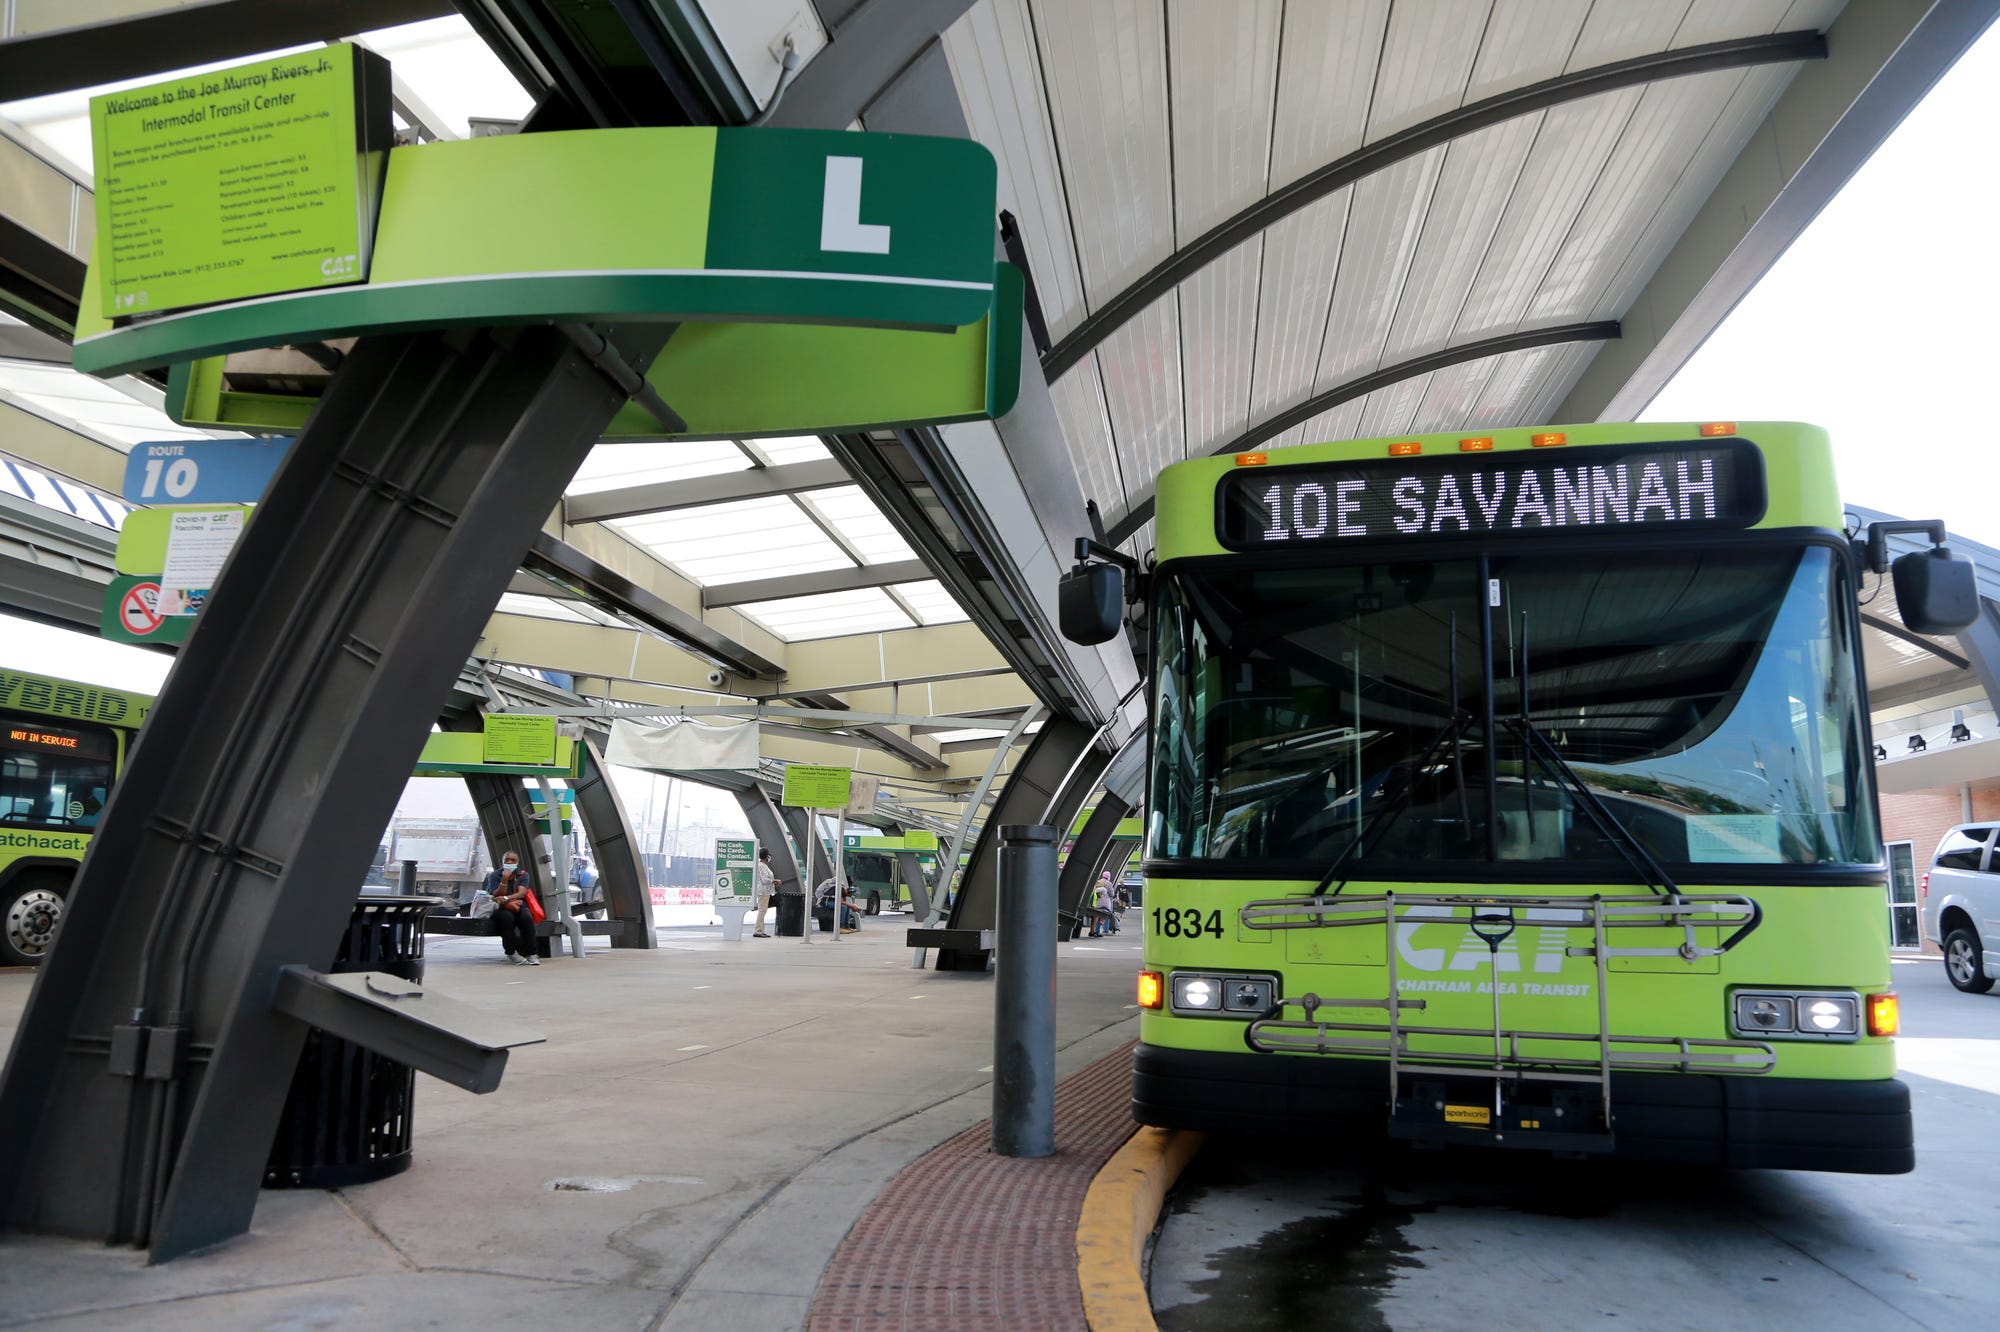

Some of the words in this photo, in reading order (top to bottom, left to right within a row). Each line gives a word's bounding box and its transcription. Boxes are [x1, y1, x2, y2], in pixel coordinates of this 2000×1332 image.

[106, 97, 158, 115] Welcome
[162, 92, 174, 103] to
[177, 86, 195, 100] the
[199, 82, 219, 97] Joe
[223, 74, 267, 92] Murray
[271, 65, 313, 83] Rivers,
[317, 58, 332, 73] Jr.
[142, 106, 206, 132] Intermodal
[209, 97, 250, 119] Transit
[254, 92, 296, 111] Center
[820, 155, 891, 254] L
[321, 254, 356, 275] CAT
[148, 446, 185, 457] ROUTE
[141, 458, 199, 498] 10
[1263, 480, 1368, 541] 10E
[1393, 459, 1716, 534] SAVANNAH
[11, 730, 27, 741] NOT
[29, 733, 40, 742] IN
[41, 734, 78, 748] SERVICE
[848, 837, 857, 846] D
[1152, 907, 1224, 939] 1834
[1396, 905, 1585, 973] CAT
[1397, 979, 1471, 993] CHATHAM
[1522, 983, 1591, 996] TRANSIT
[1446, 1109, 1489, 1119] sportworks
